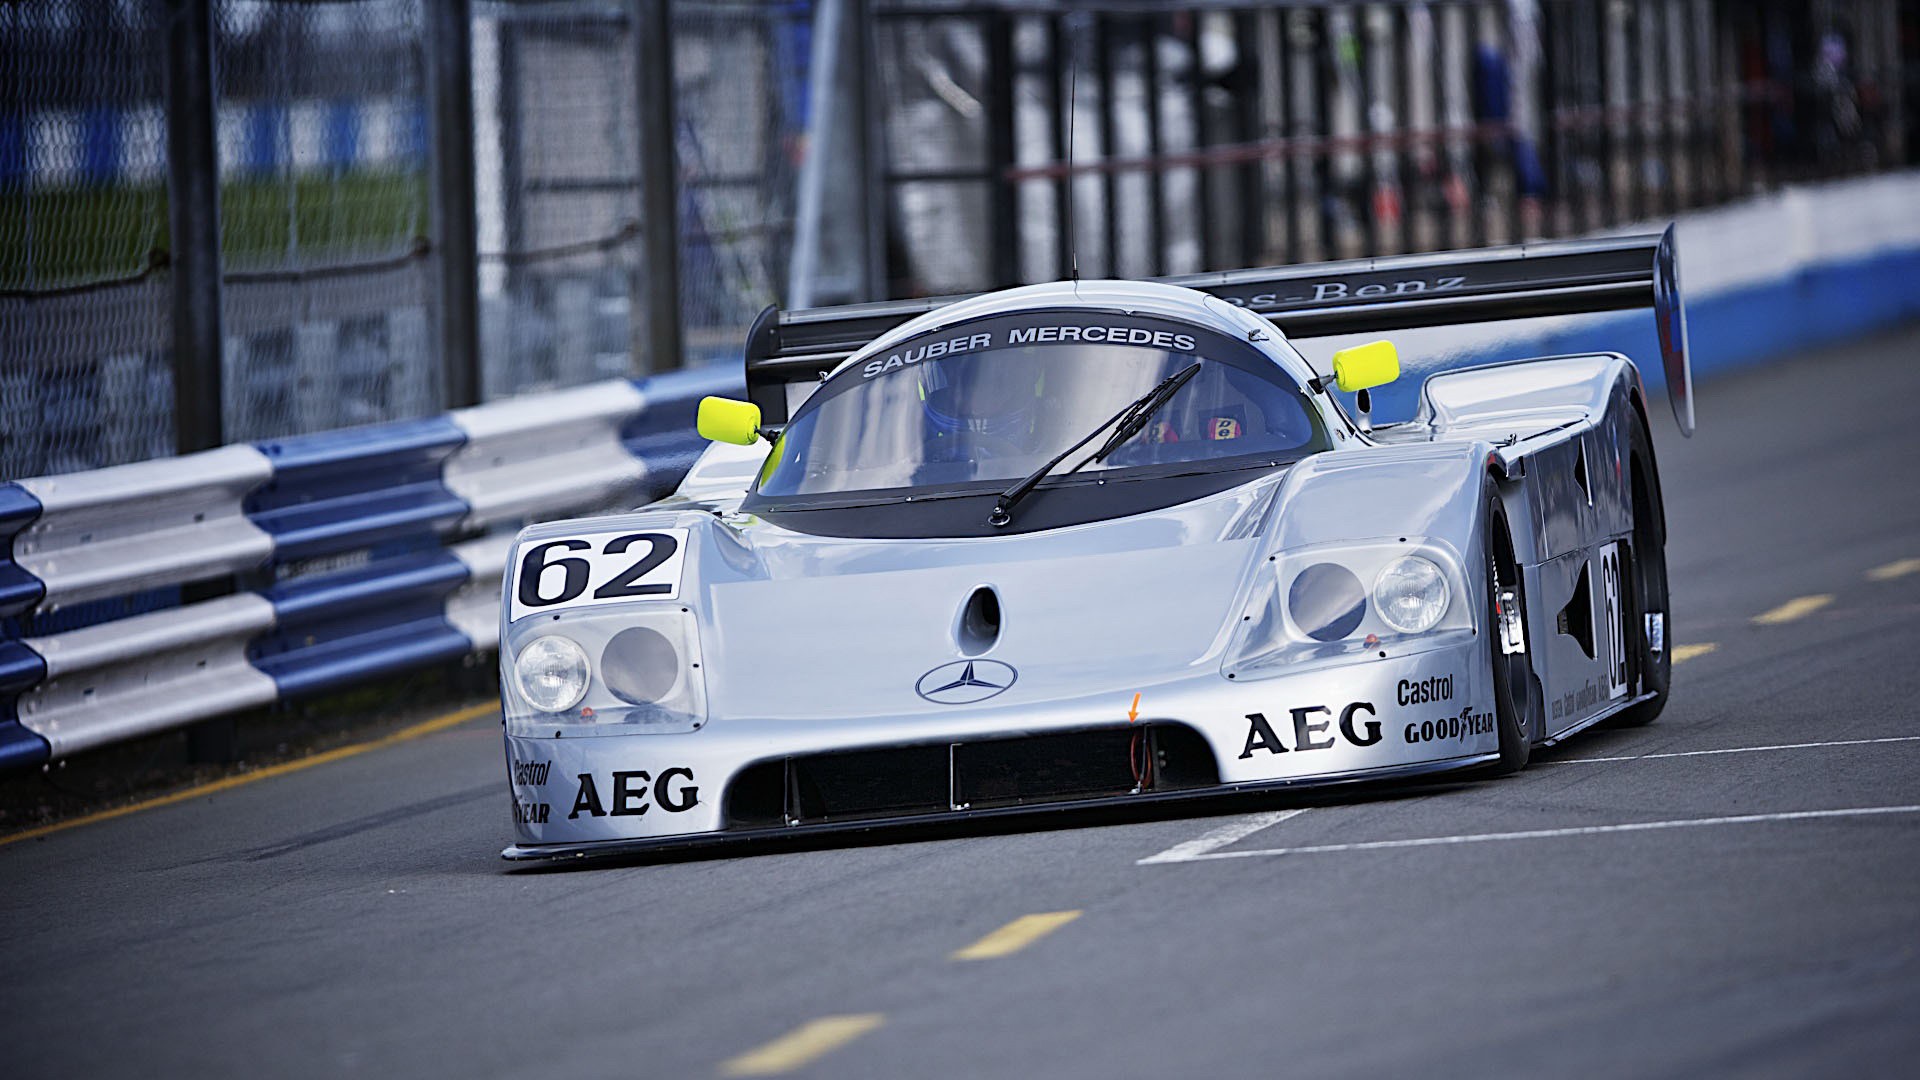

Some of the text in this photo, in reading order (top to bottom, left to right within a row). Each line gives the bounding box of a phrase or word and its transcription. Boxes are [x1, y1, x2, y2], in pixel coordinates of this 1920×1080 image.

[863, 326, 1196, 378] SAUBER MERCEDES
[518, 532, 678, 607] 62
[1397, 673, 1453, 707] Castrol
[1238, 702, 1383, 760] AEG
[514, 760, 552, 786] Castrol
[568, 767, 699, 820] AEG
